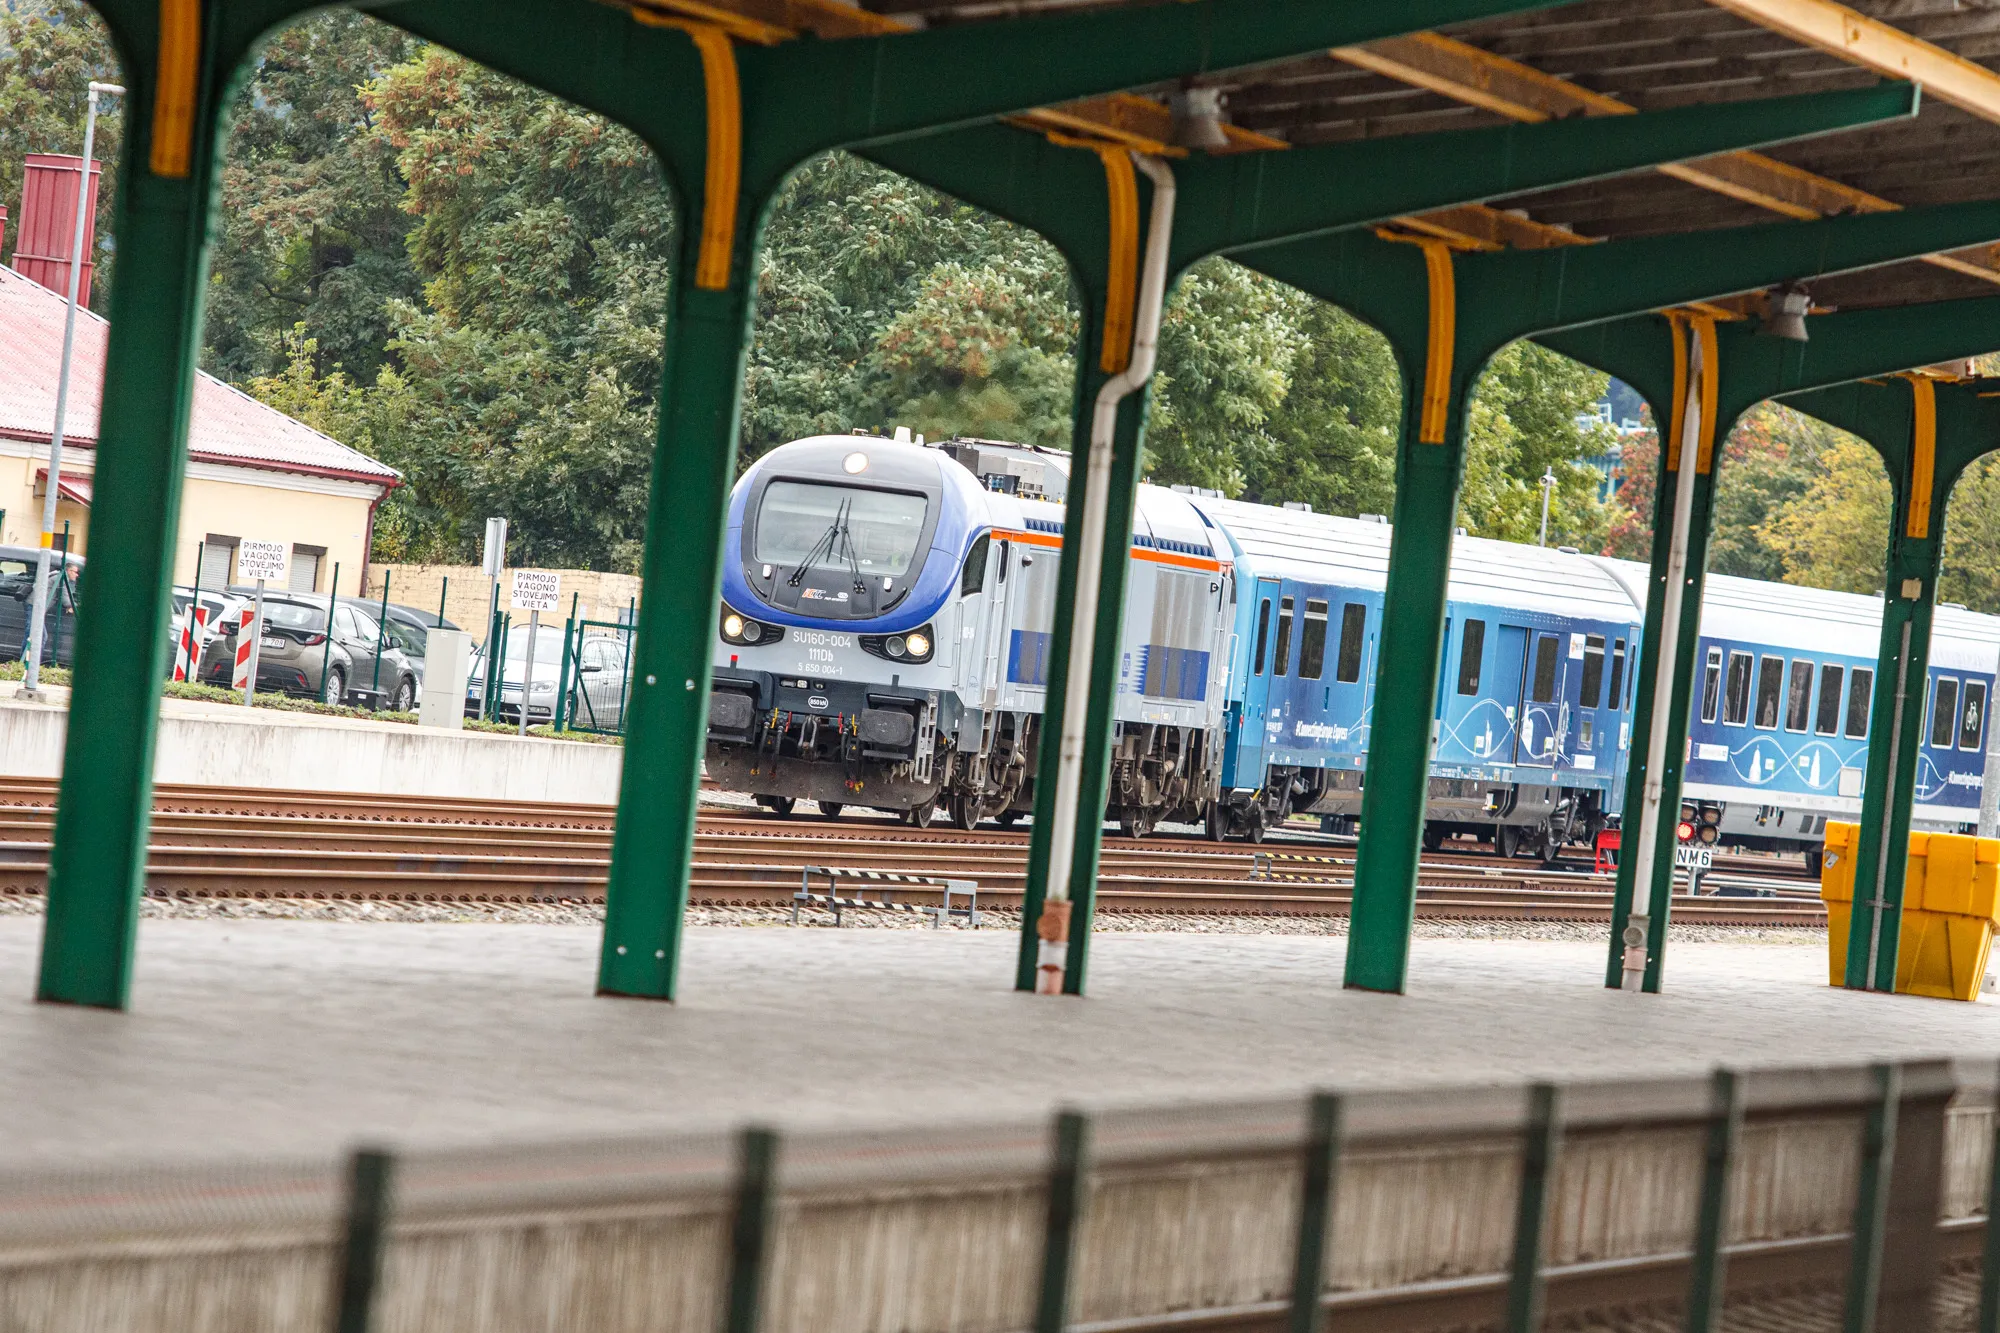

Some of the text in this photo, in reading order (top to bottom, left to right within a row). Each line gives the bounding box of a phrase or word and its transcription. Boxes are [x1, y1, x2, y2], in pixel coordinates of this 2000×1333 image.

[243, 541, 284, 552] PIRMOJO
[243, 551, 282, 561] VAGONO
[248, 569, 275, 578] VIETA
[517, 572, 557, 583] PIRMOJO
[517, 581, 556, 592] VAGONO
[522, 600, 548, 609] VIETA
[793, 631, 851, 648] SU160-004
[808, 647, 834, 661] 111Db
[805, 663, 820, 673] 650
[822, 665, 843, 676] 004-1
